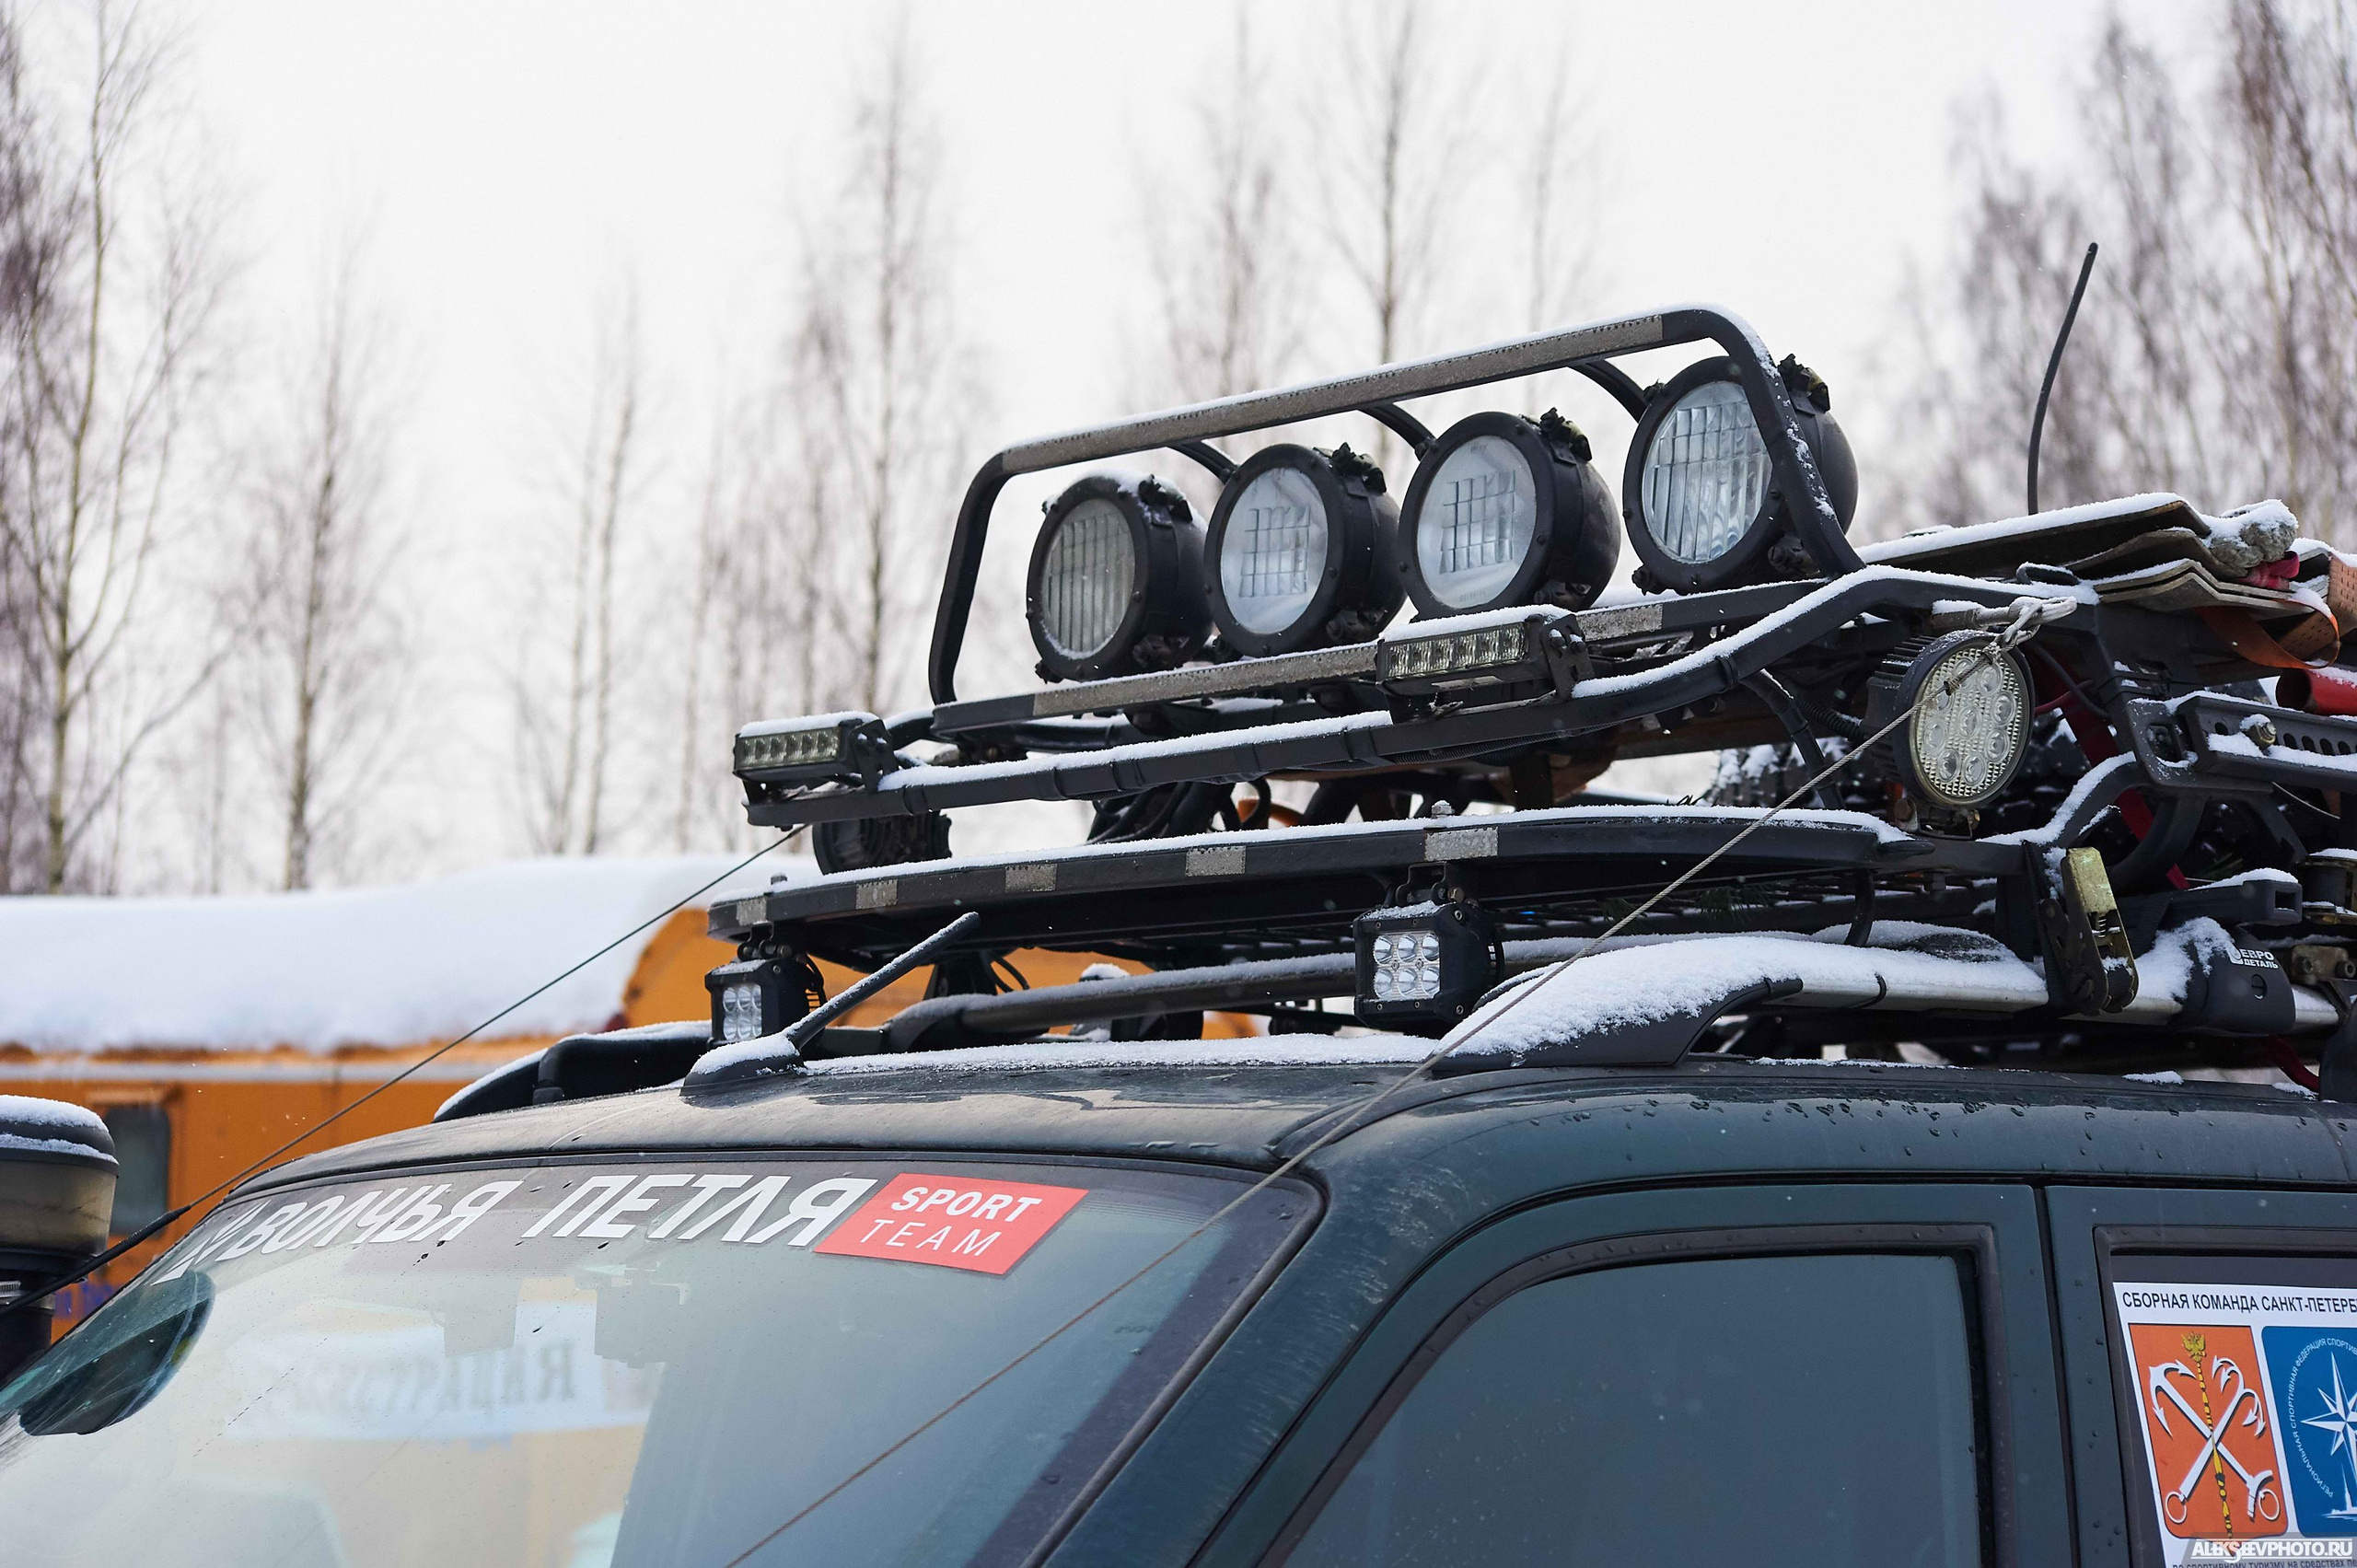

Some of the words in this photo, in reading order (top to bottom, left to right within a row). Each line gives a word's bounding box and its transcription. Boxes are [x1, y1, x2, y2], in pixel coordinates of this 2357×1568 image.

[2239, 948, 2274, 960] ЕВРО
[2244, 958, 2278, 969] ДЕТАЛЬ
[215, 1180, 524, 1262] ВОЛЧЬЯ
[521, 1174, 878, 1247] ПЕТЛЯ
[891, 1186, 1043, 1223] SPORT
[859, 1219, 1003, 1257] TEAM
[2122, 1292, 2189, 1309] СБОРНАЯ
[2192, 1294, 2259, 1313] КОМАНДА
[2261, 1295, 2357, 1313] САНКТ-ПЕТЕРБ
[2295, 1339, 2327, 1366] ФЕДЕРАЦИЯ
[2288, 1366, 2298, 1429] СПОРТИВНАЯ
[2293, 1431, 2334, 1498] РЕГИОНАЛЬНАЯ
